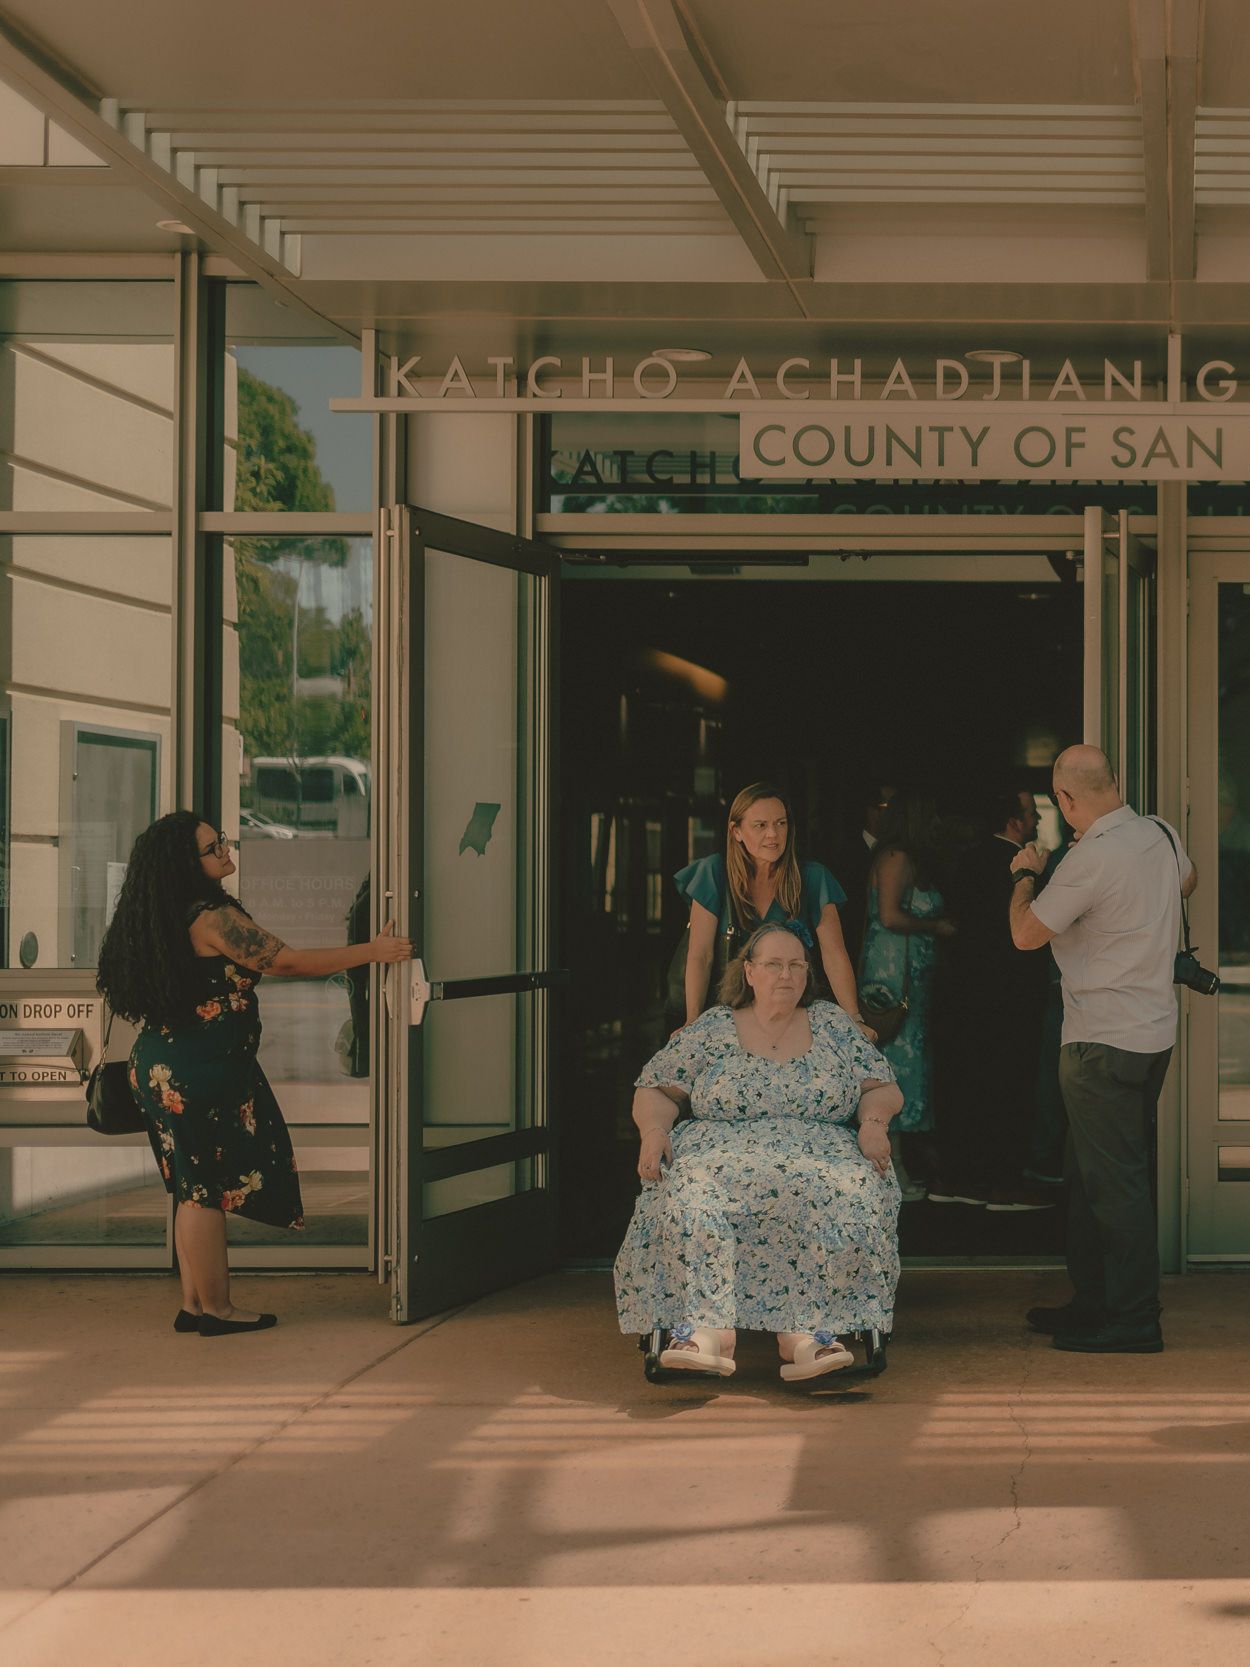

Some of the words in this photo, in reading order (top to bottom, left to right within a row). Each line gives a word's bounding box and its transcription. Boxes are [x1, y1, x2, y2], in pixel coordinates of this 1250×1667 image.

[389, 356, 680, 399] KATCHO
[724, 357, 1143, 401] ACHADJIAN
[753, 424, 991, 468] COUNTY
[1014, 426, 1086, 468] OF
[1111, 426, 1224, 470] SAN
[241, 879, 296, 890] OFFICE
[300, 879, 354, 890] HOURS
[23, 1004, 62, 1019] DROP
[67, 1004, 94, 1019] OFF
[10, 1072, 27, 1081] TO
[31, 1072, 67, 1081] OPEN
